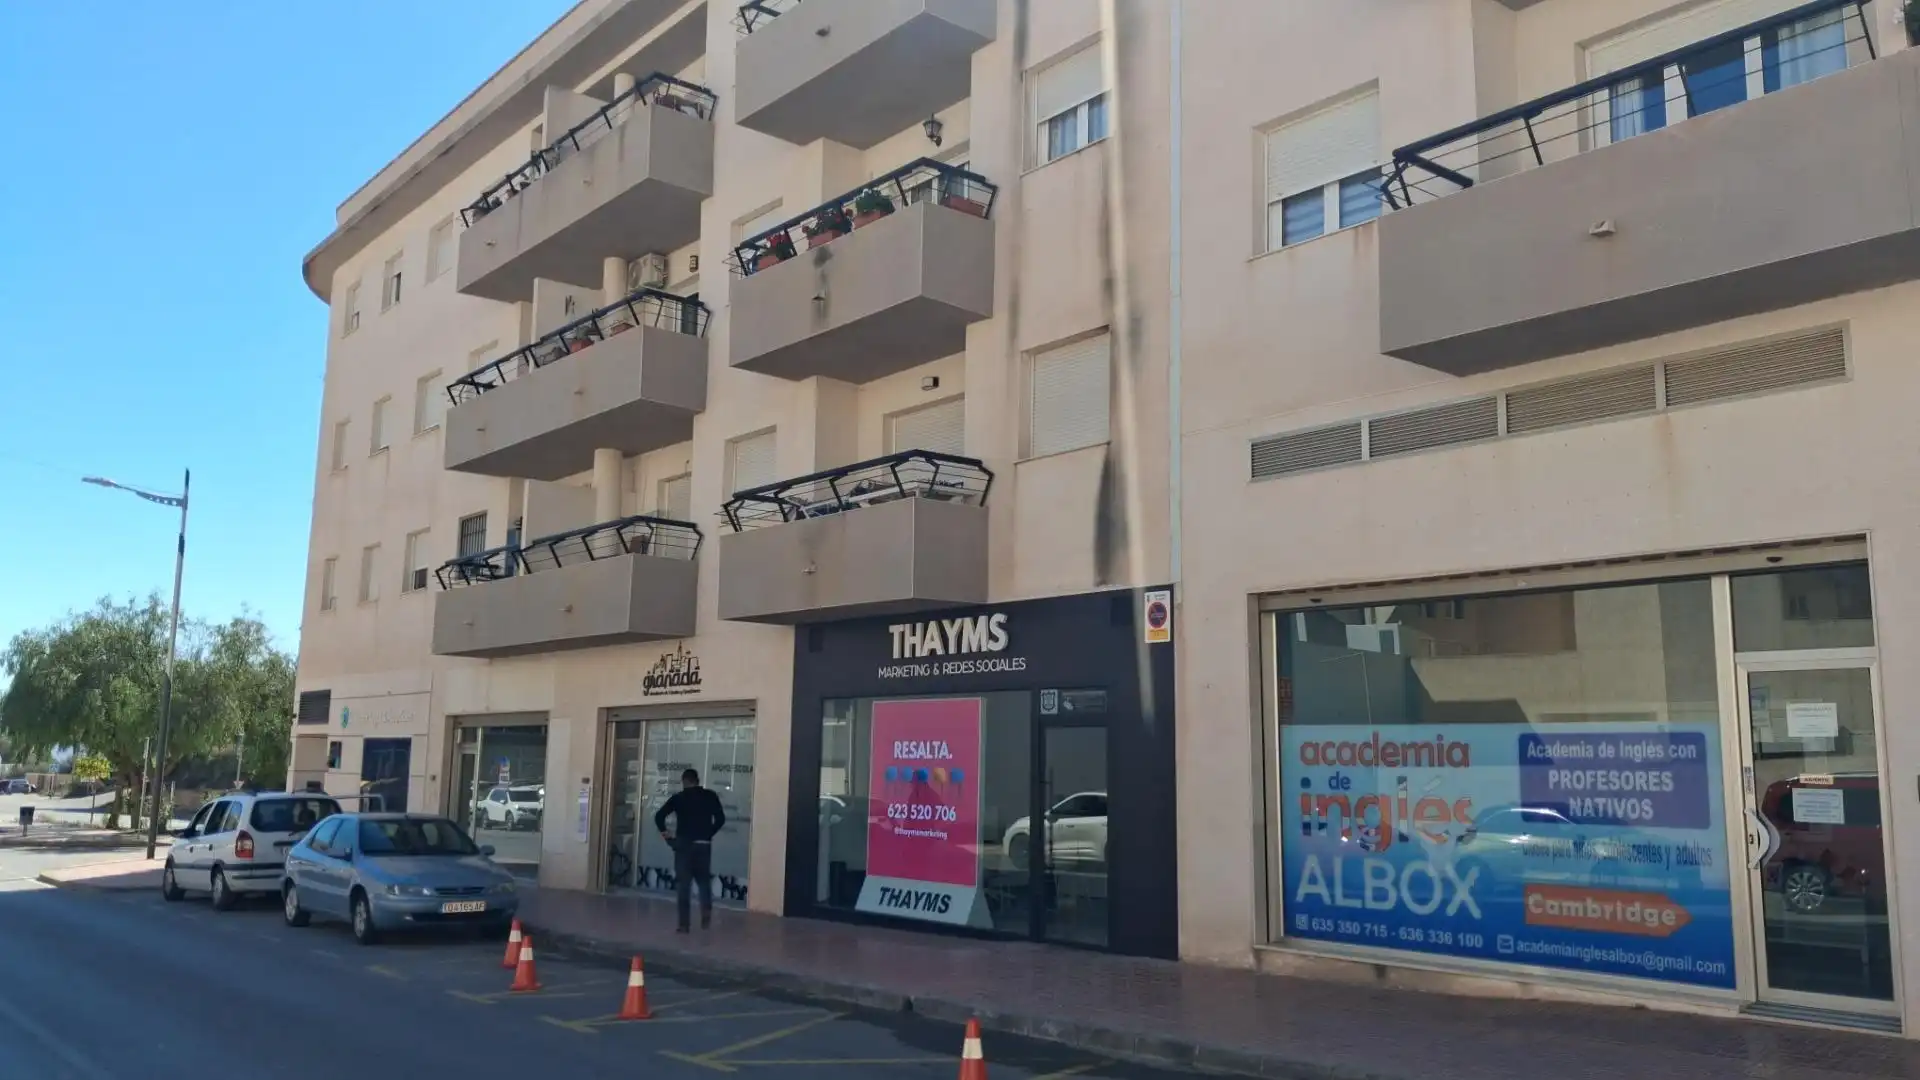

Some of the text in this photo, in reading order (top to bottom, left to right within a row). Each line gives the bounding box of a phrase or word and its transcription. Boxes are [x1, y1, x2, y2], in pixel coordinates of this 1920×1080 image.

[888, 613, 1009, 659] THAYMS
[643, 658, 702, 697] granada
[878, 657, 1027, 679] MARKETING & REDES SOCIALES
[893, 740, 953, 760] RESALTA.
[1300, 731, 1470, 768] academia
[1527, 740, 1594, 759] Academia
[1597, 741, 1616, 758] de
[1669, 747, 1697, 759] con
[1328, 771, 1351, 791] de
[1549, 769, 1675, 792] PROFESORES
[887, 803, 957, 821] 623 520 706
[1300, 773, 1478, 854] inglés
[1569, 797, 1655, 820] NATIVOS
[1664, 847, 1671, 871] y
[878, 886, 952, 915] THAYMS
[1295, 853, 1482, 920] ALBOX
[1527, 891, 1677, 927] Cambridge
[1311, 917, 1334, 932] 635
[1337, 920, 1361, 936] 350
[1364, 923, 1388, 938] 715
[1398, 926, 1424, 942] 636
[1427, 929, 1453, 945] 336
[1457, 932, 1484, 949] 100
[1516, 938, 1726, 975] academiainglesalbox@gmail.com
